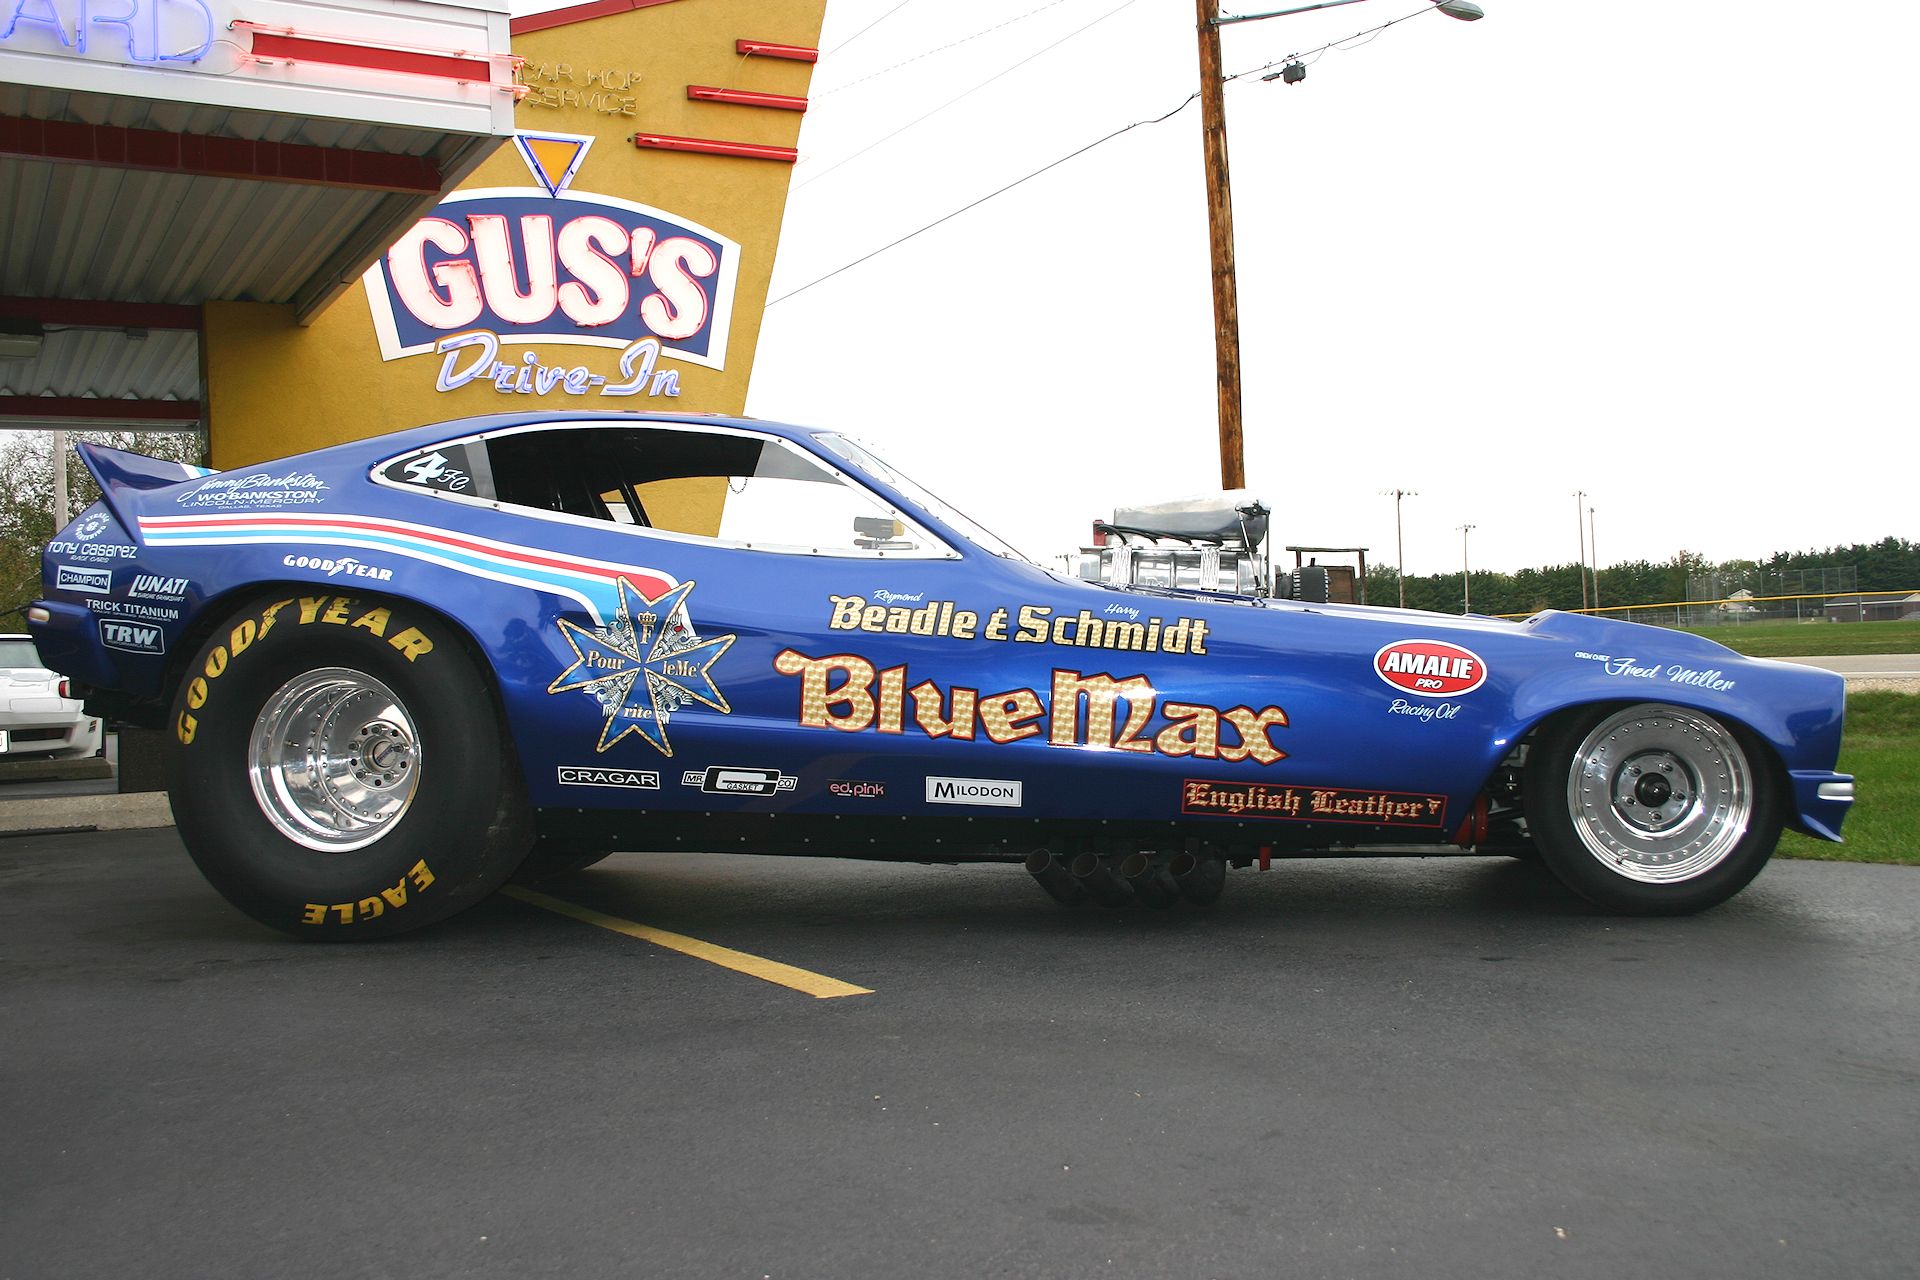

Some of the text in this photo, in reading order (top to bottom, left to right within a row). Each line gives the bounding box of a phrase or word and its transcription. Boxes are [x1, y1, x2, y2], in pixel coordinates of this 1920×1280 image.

[587, 68, 642, 91] HOP
[388, 214, 718, 340] GUS'S
[435, 330, 682, 398] Drive-In
[182, 498, 325, 509] LINCOLN-MERCURY
[60, 572, 109, 587] CHAMPION
[128, 574, 190, 598] LUNATI
[873, 589, 924, 603] Raymond
[85, 598, 121, 612] TRICK
[123, 603, 180, 620] TITANIUM
[1103, 603, 1140, 618] Harry
[104, 624, 159, 646] TRW
[828, 594, 978, 641] Beadle
[1013, 603, 1211, 656] Schmidt
[586, 650, 626, 671] Pour
[1383, 651, 1475, 680] AMALIE
[1414, 677, 1444, 690] PRO
[1605, 657, 1736, 692] Fred Miller
[1387, 698, 1462, 723] Racing Oil
[560, 769, 657, 787] CRAGAR
[727, 782, 761, 791] GASKET
[1186, 782, 1424, 822] English Leather
[302, 858, 436, 926] EAGLE
